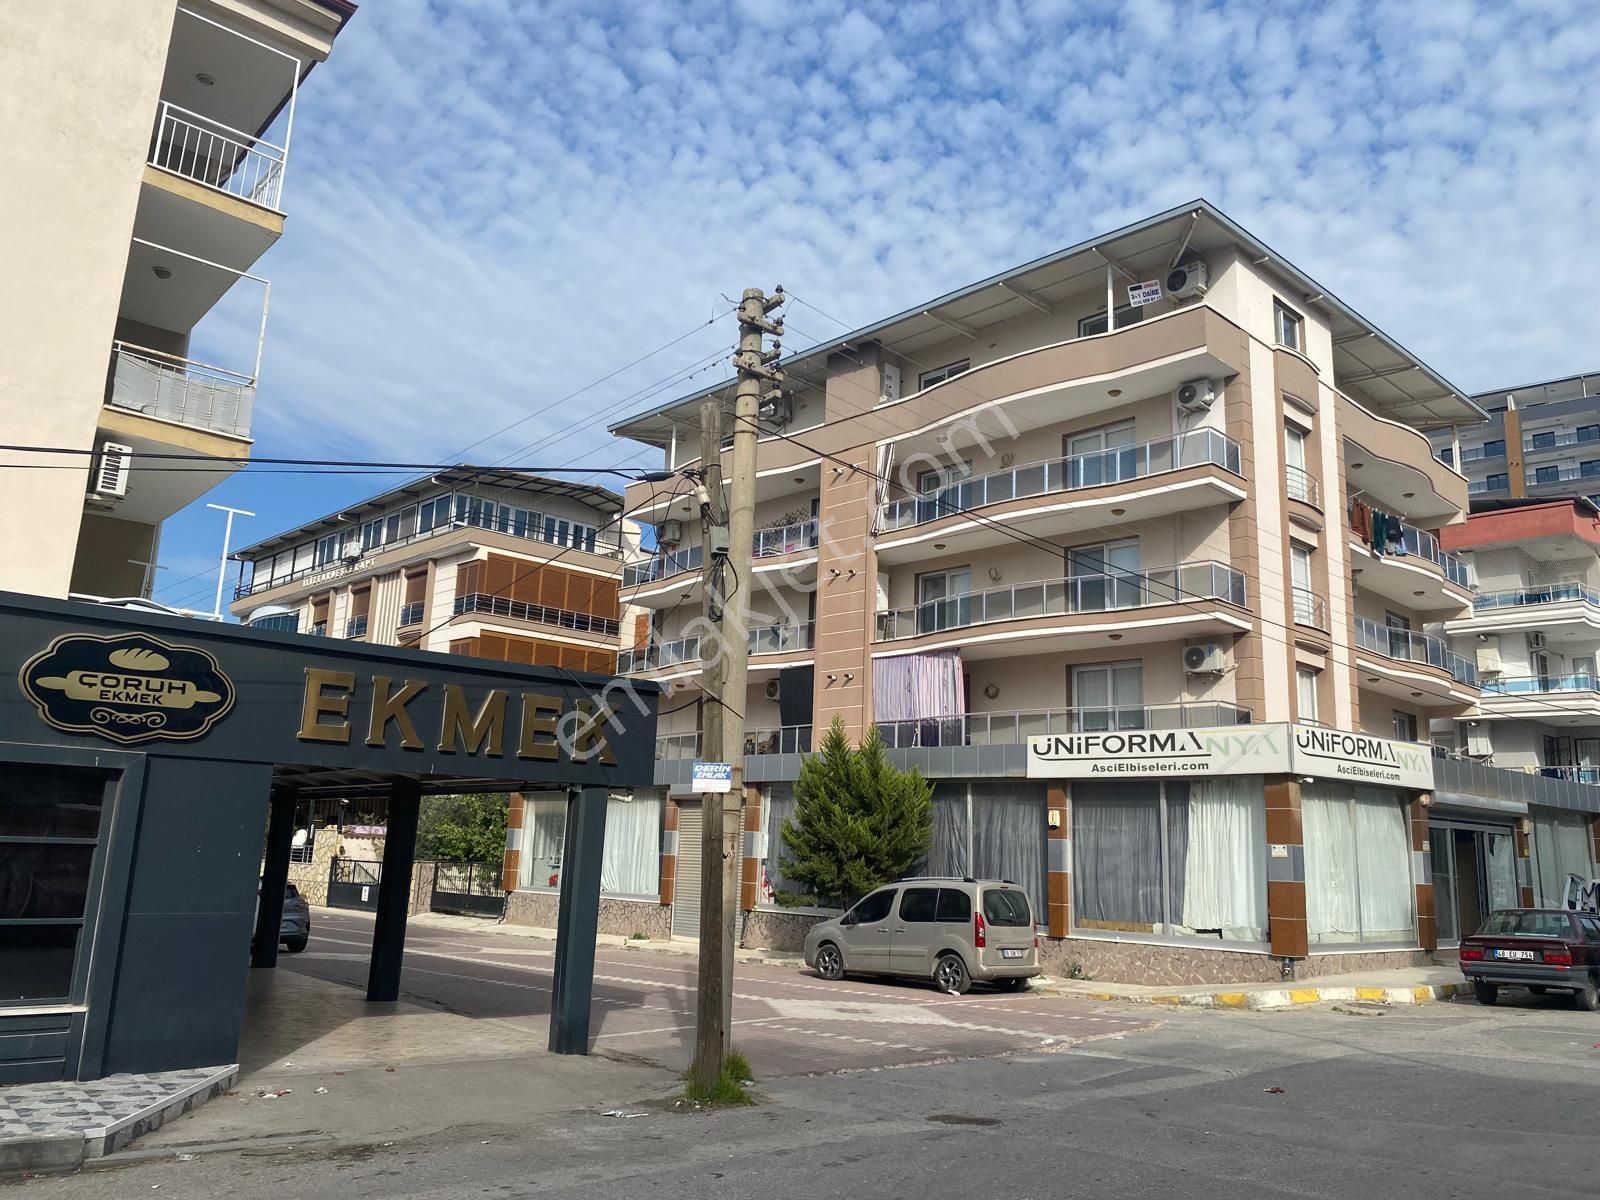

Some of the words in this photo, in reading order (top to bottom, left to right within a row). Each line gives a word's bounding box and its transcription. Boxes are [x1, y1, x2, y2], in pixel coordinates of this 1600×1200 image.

[78, 672, 187, 696] ÇORUH
[99, 689, 163, 706] EKMEK
[297, 667, 620, 766] EKMEK
[695, 771, 728, 779] EMLAK
[1091, 761, 1209, 773] AsciElbiseleri.com
[1336, 764, 1401, 782] AsciElbiseleri.com
